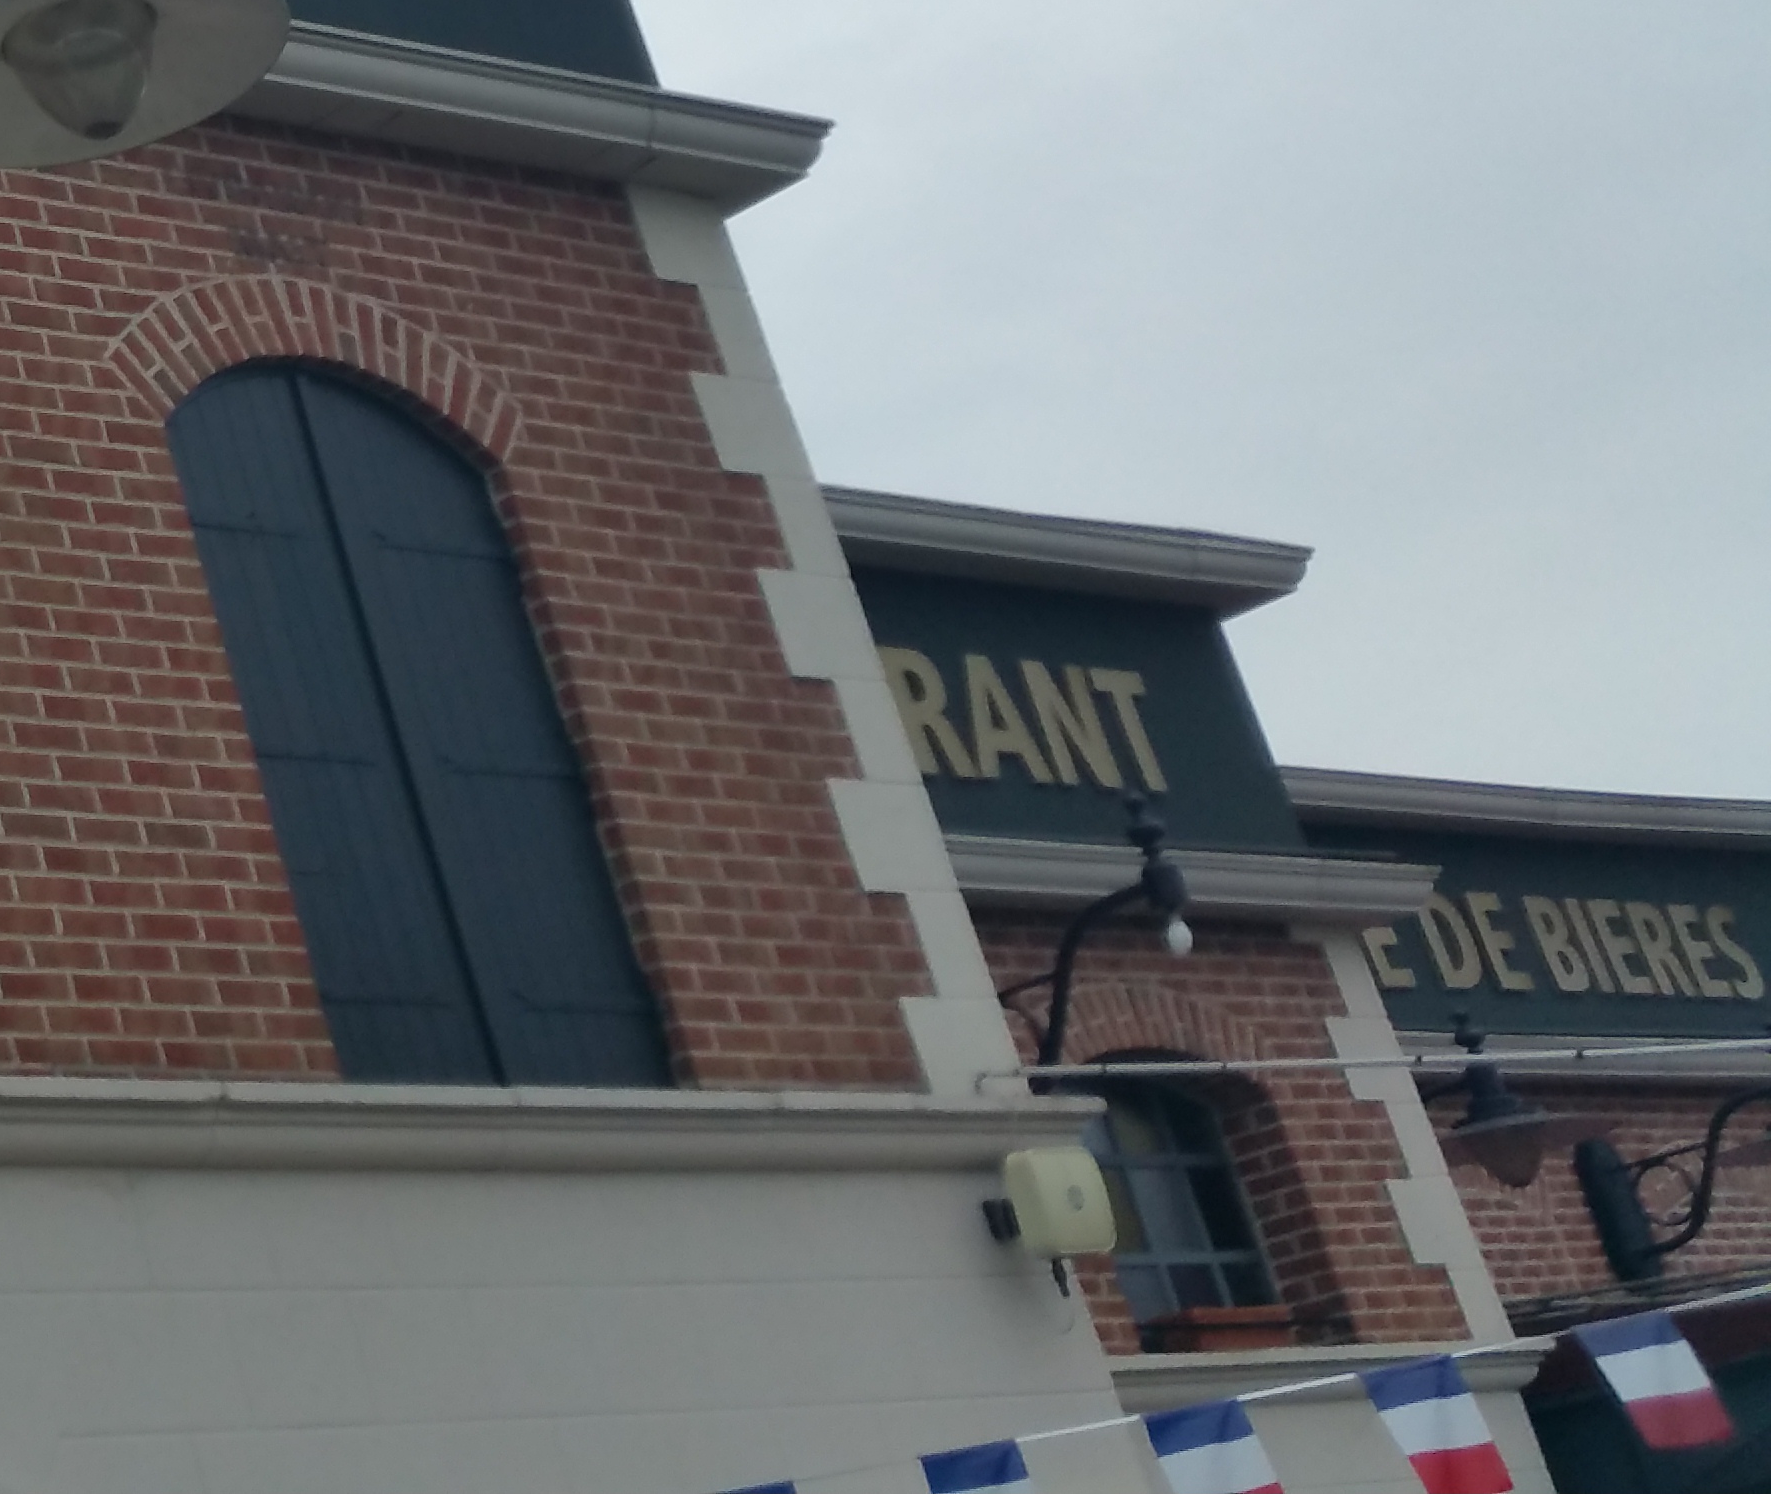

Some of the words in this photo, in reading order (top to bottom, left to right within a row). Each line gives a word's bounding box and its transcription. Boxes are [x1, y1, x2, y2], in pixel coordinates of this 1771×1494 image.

[875, 644, 1168, 792] RANT
[1419, 891, 1535, 991] DE
[1522, 895, 1764, 1000] BIERES
